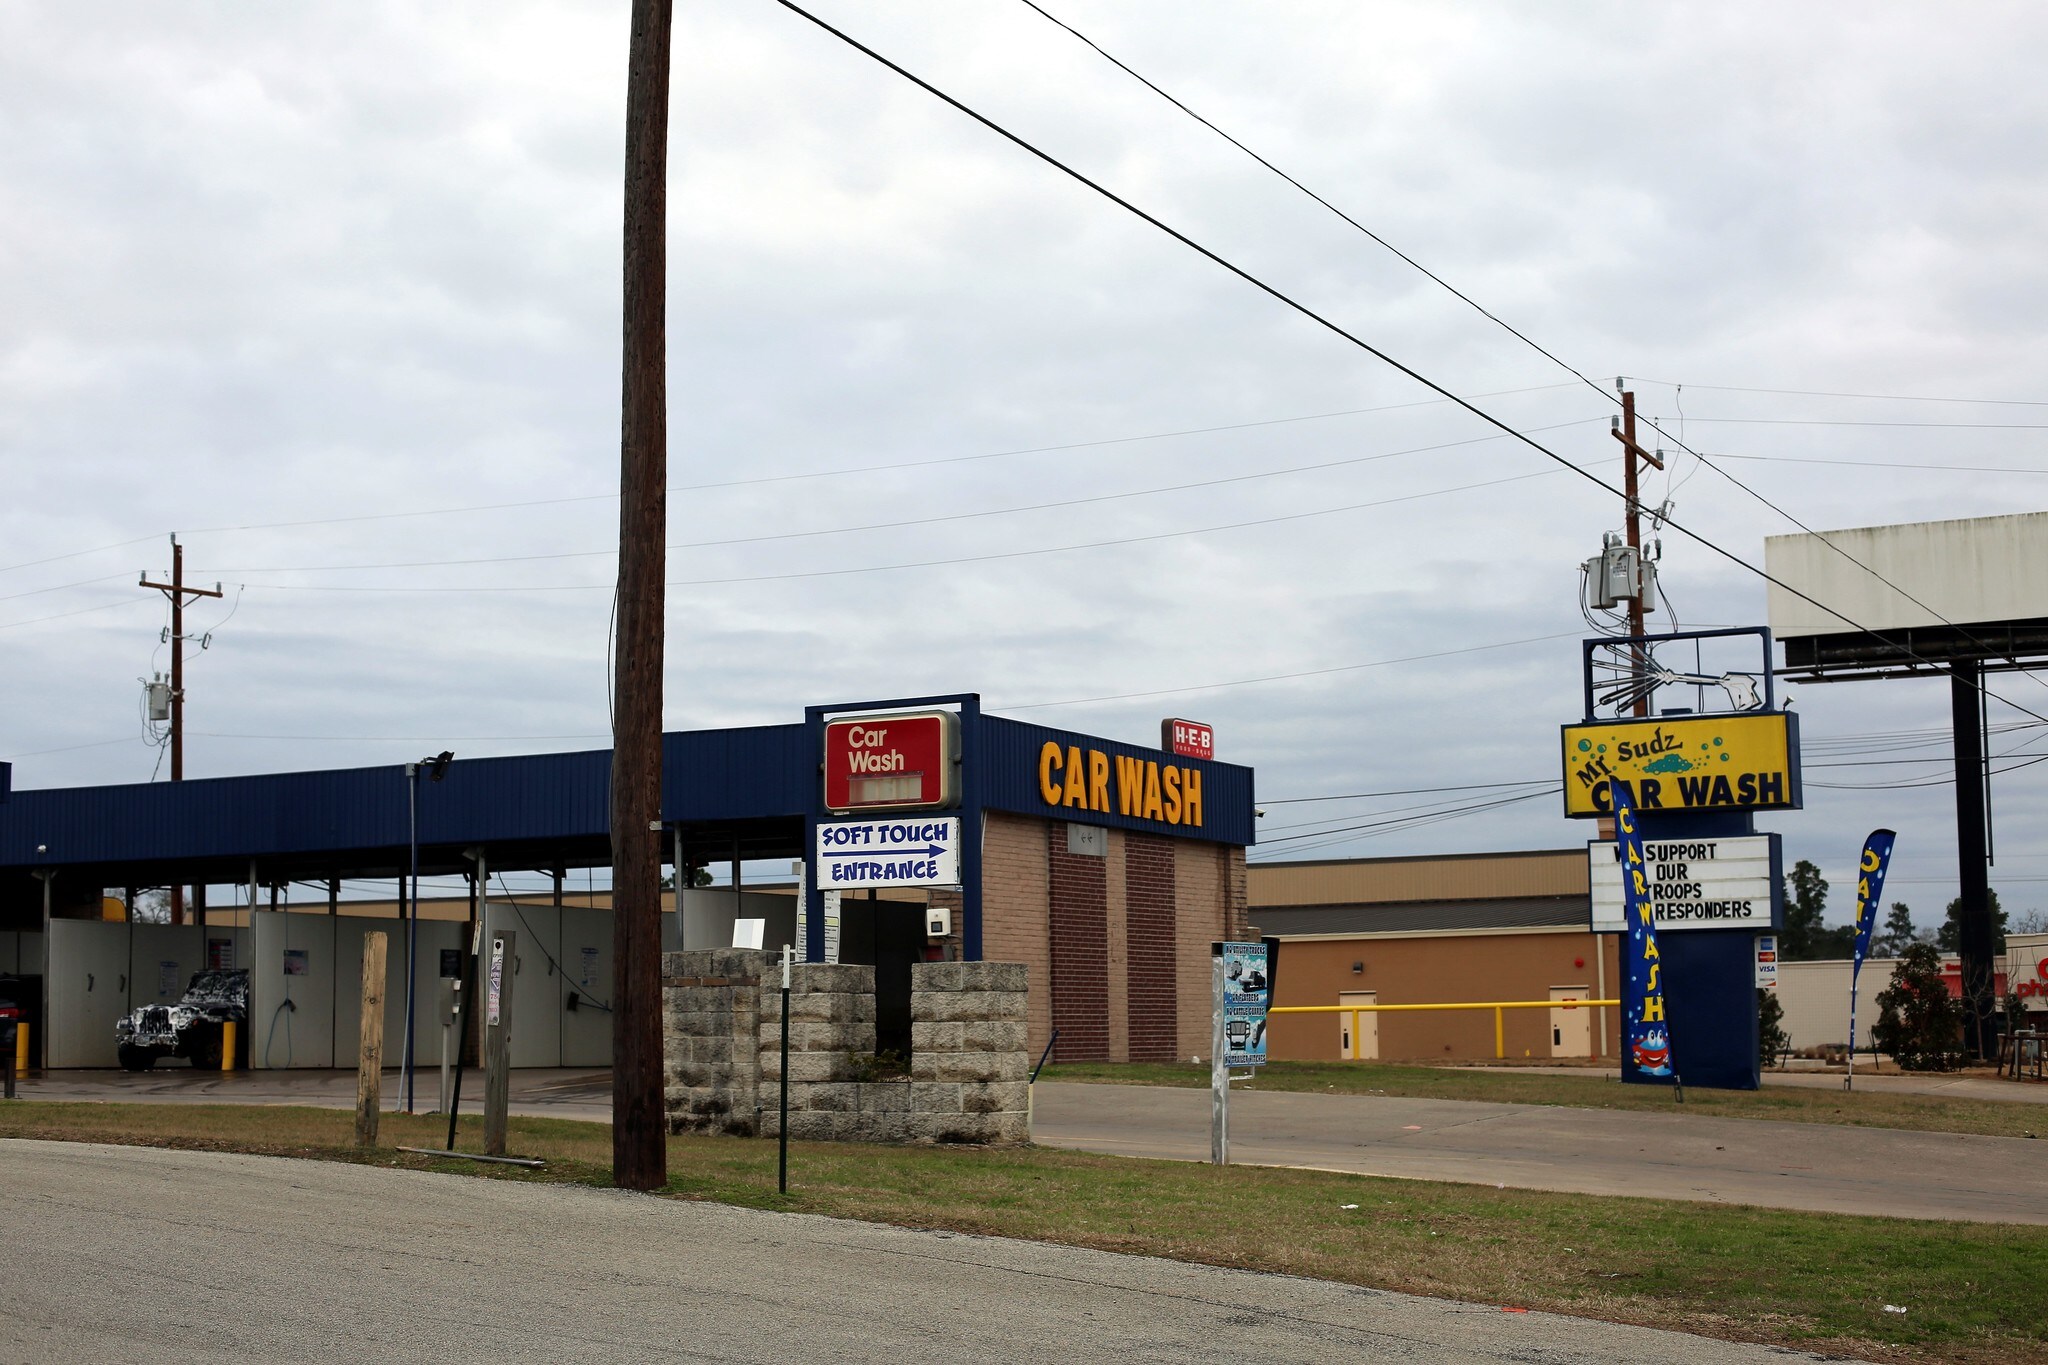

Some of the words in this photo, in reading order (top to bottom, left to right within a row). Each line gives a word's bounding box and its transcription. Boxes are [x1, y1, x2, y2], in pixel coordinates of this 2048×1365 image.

[848, 726, 888, 748] Car
[848, 749, 905, 773] Wash
[1576, 755, 1612, 789] Mr
[1618, 726, 1683, 761] Sudz
[1039, 741, 1111, 814] CAR
[1115, 754, 1203, 827] WASH
[1677, 772, 1783, 807] WASH
[822, 825, 874, 846] SOFT
[878, 822, 949, 844] TOUCH
[1645, 843, 1717, 862] SUPPORT
[831, 859, 939, 882] ENTRANCE
[1656, 863, 1688, 881] OUR
[1647, 883, 1702, 899] ROOPS
[1655, 901, 1752, 920] RESPONDERS
